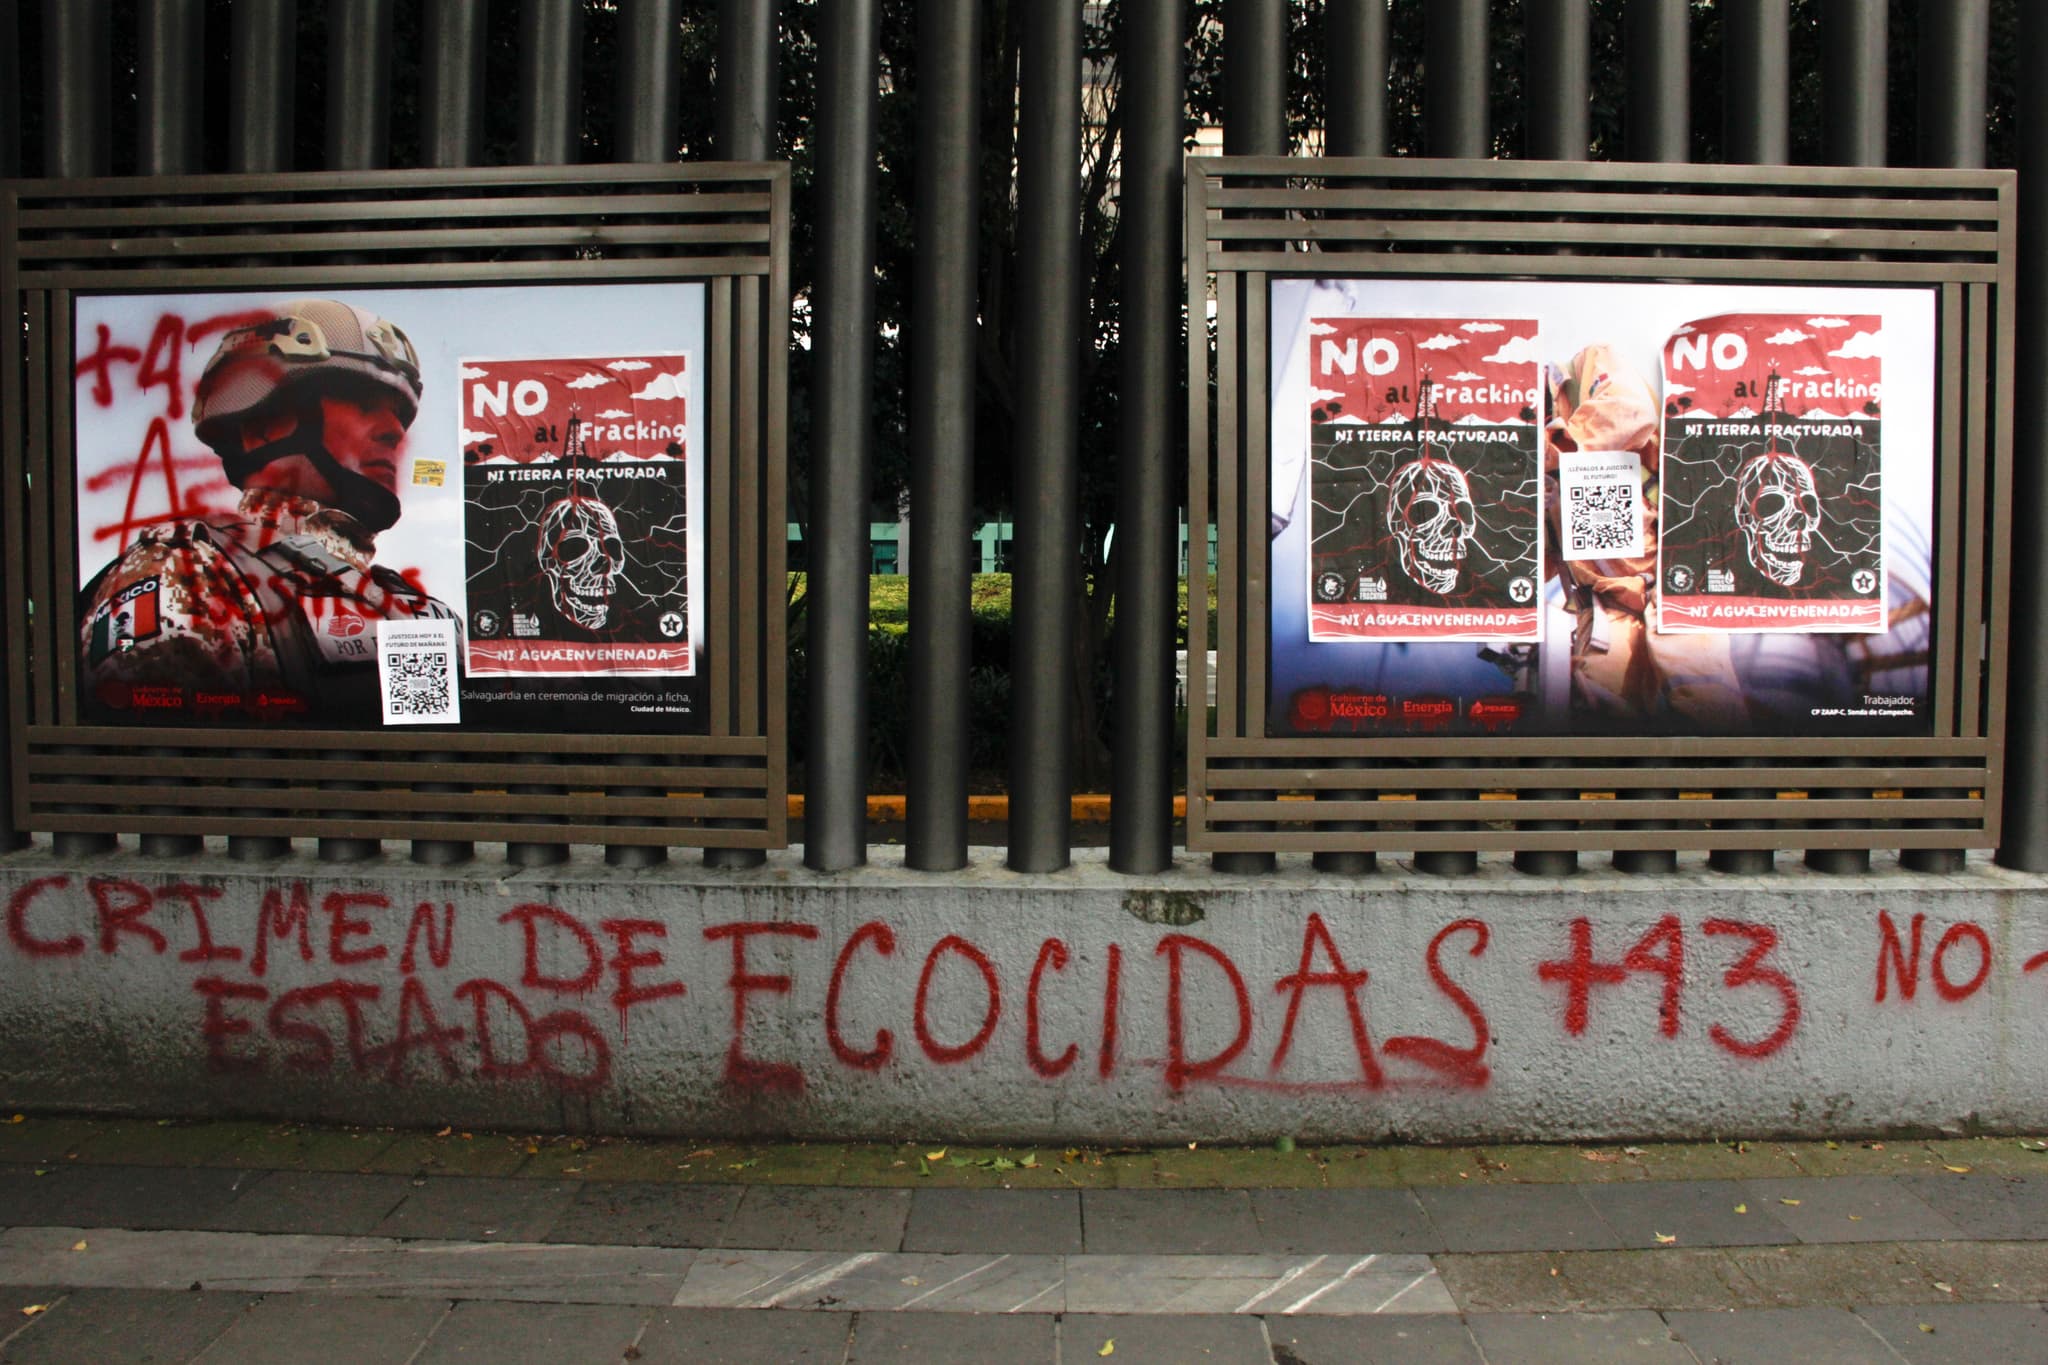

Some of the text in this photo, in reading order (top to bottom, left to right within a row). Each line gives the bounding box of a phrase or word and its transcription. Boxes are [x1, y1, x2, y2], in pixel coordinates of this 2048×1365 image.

[1320, 338, 1399, 376] NO
[1672, 333, 1748, 371] NO
[472, 379, 548, 417] NO
[1386, 383, 1538, 409] al Fracking
[1733, 378, 1882, 404] al Fracking
[534, 420, 686, 444] al Fracking
[1335, 429, 1519, 442] NI TIERRA FRACTURADA
[1685, 423, 1863, 436] NI TIERRA FRACTURADA
[487, 467, 667, 482] NI TIERRA FRACTURADA
[1340, 613, 1518, 626] NI AGUA ENVENENADA
[1690, 605, 1863, 617] NI AGUA ENVENENADA
[335, 638, 368, 656] POR
[498, 648, 668, 661] NI AGUA ENVENENADA
[461, 690, 522, 705] Salvaguardia
[538, 691, 589, 701] ceremonia
[591, 691, 604, 701] de
[606, 692, 654, 704] migración
[665, 692, 691, 703] ficha,
[1863, 695, 1915, 707] Trabajador,
[1330, 702, 1387, 717] México
[7, 876, 686, 1008] CRIMEN DE
[703, 909, 1993, 1102] ECOCIDAS +43 NO
[195, 977, 610, 1090] ESTADO
